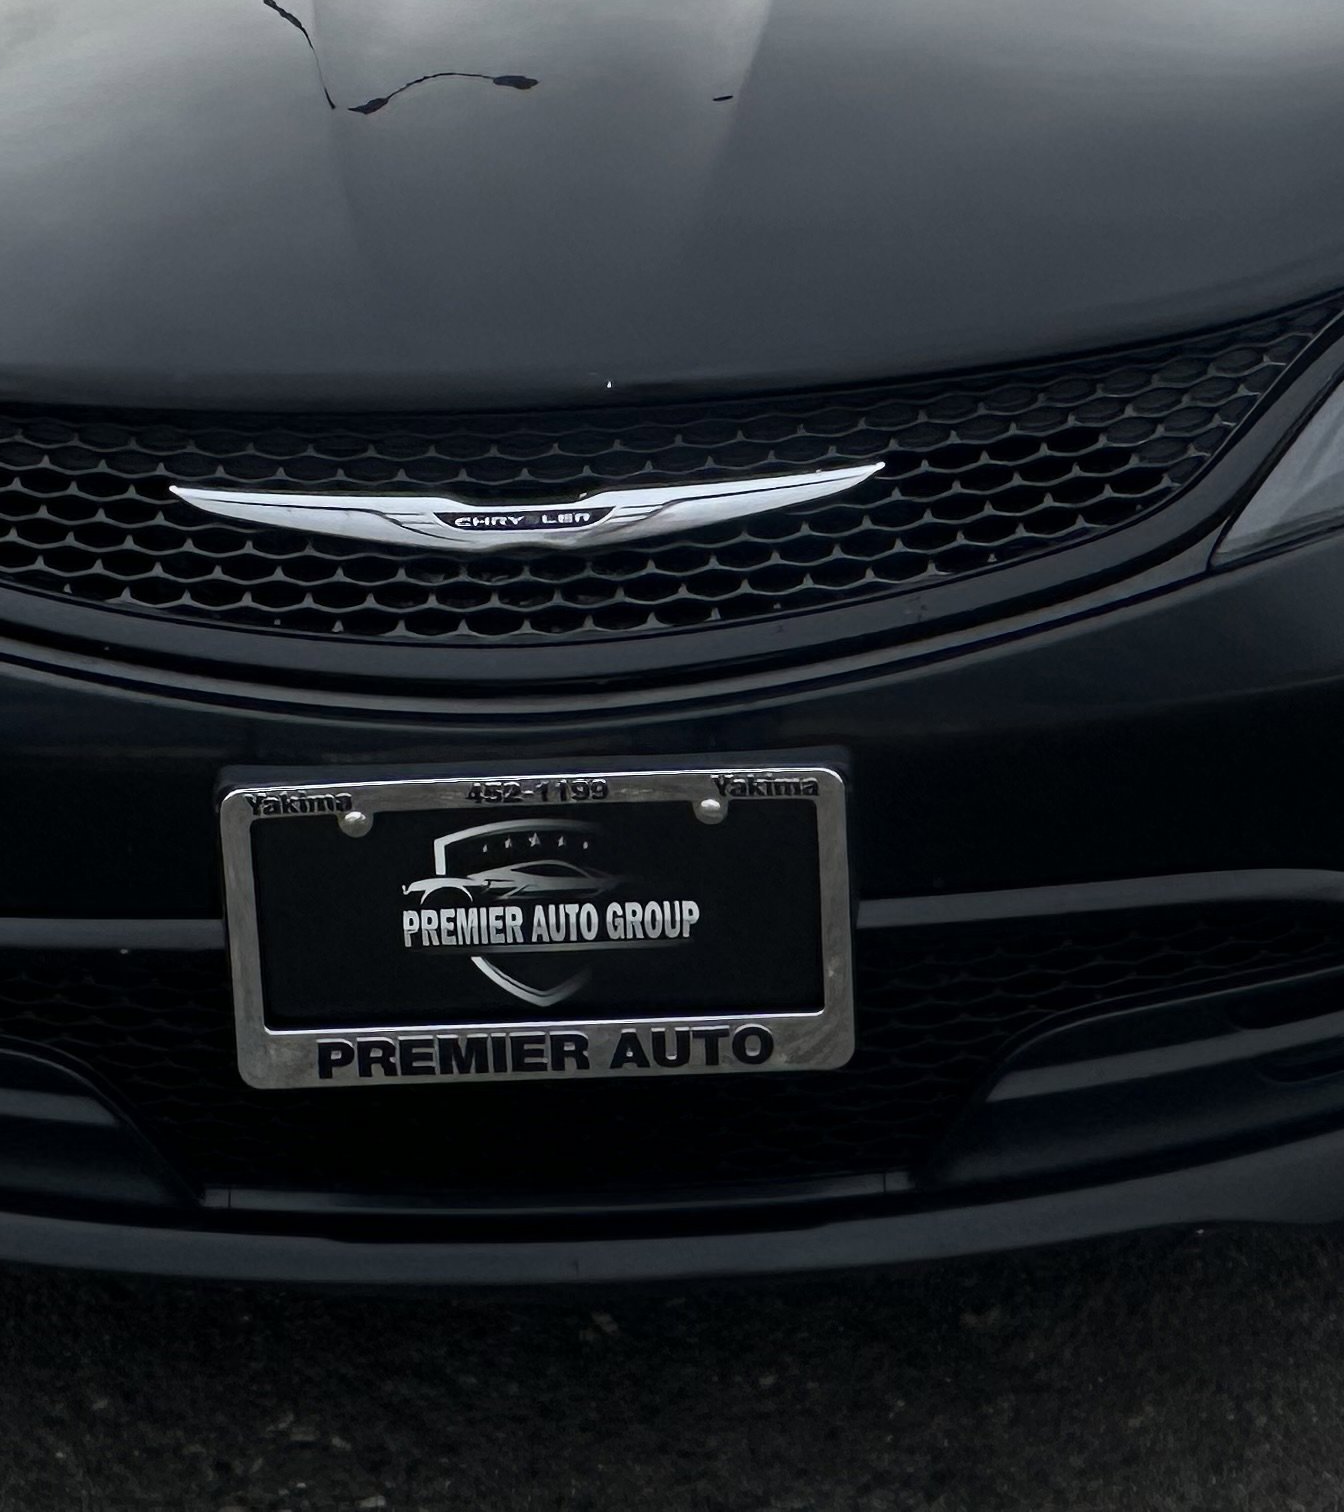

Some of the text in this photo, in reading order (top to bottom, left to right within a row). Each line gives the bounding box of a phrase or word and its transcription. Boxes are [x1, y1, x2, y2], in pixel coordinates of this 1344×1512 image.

[465, 777, 610, 804] 452-1199
[710, 772, 820, 798] Yakima
[244, 791, 353, 816] Yakima
[403, 899, 701, 948] PREMIER AUTO GROUP
[317, 1023, 775, 1080] PREMIER AUTO
